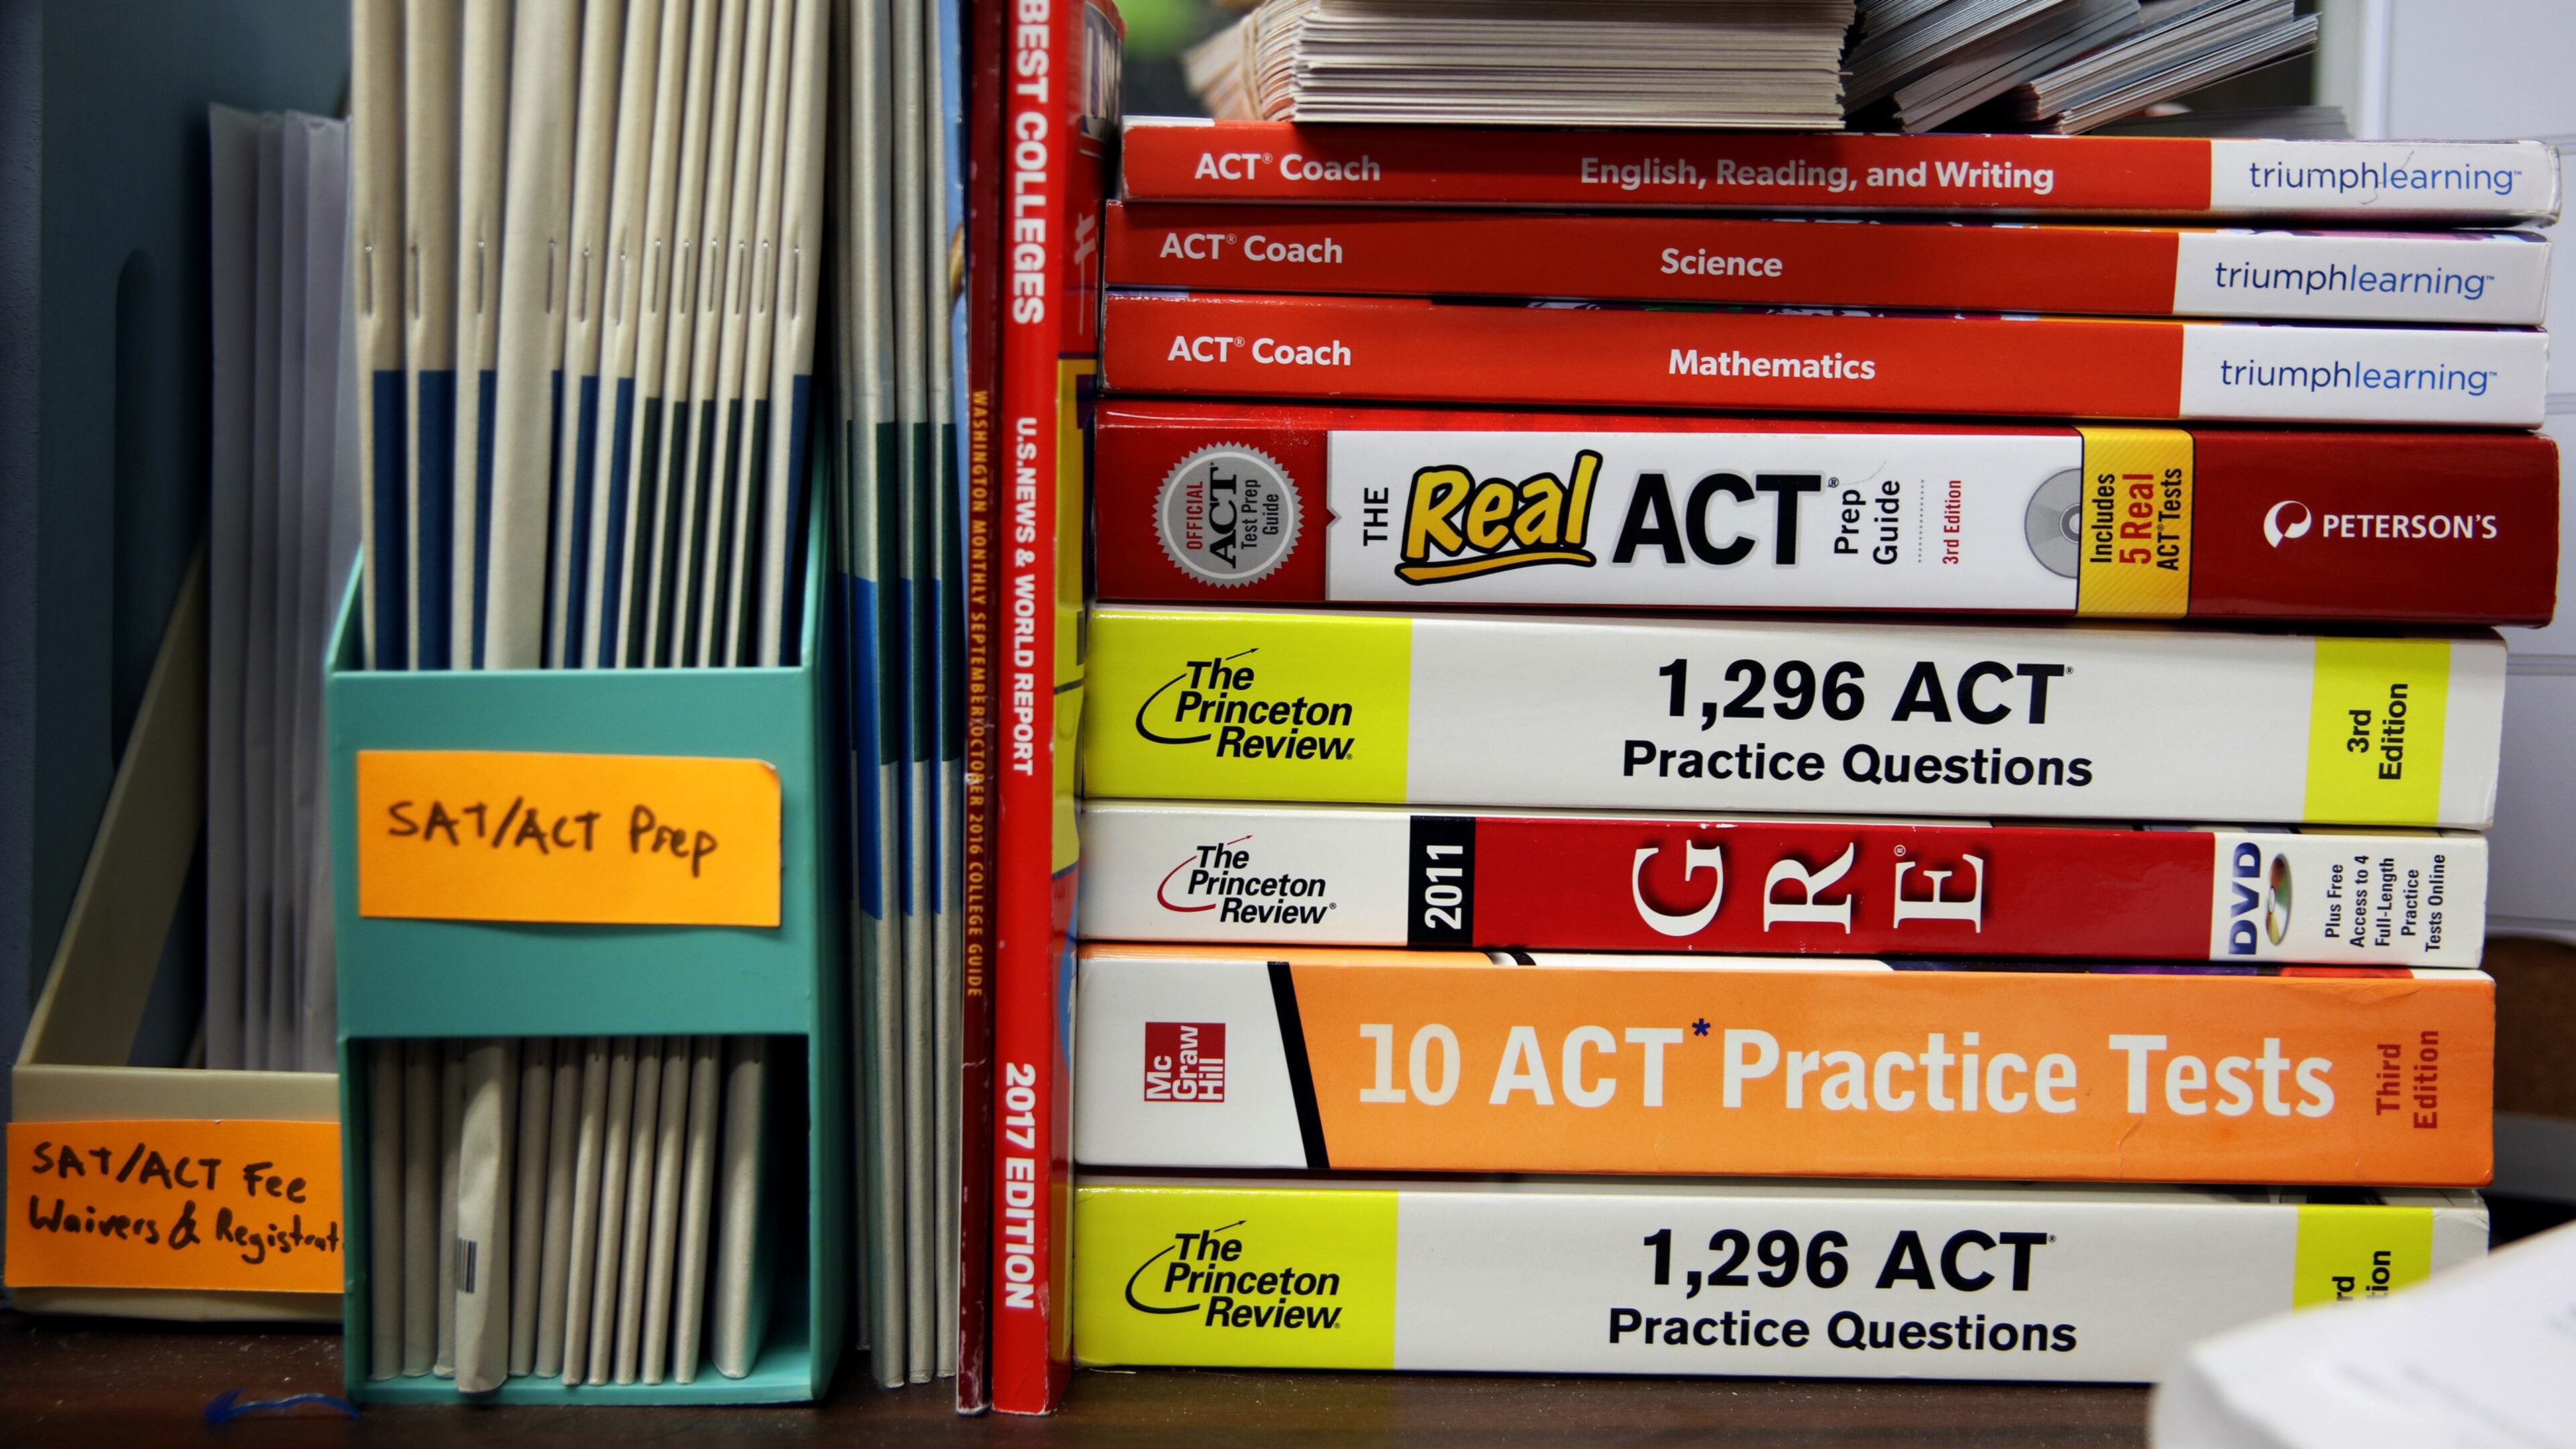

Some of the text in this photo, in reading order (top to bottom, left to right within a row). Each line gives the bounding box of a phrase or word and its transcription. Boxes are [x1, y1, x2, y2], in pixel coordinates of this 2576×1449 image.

[1013, 0, 1050, 324] BEST COLLEGES
[1279, 154, 1380, 182] Coach
[1581, 158, 2054, 194] English, Reading, and Writing
[1244, 235, 1343, 264] Coach
[1660, 248, 1783, 277] Science
[1252, 337, 1351, 367] Coach
[1668, 349, 1876, 380] Mathematics
[971, 390, 988, 513] WASHINGTON
[1186, 481, 1203, 550] OFFICIAL
[1241, 478, 1261, 549] Test Prep
[1262, 493, 1280, 536] Guide
[1363, 486, 1389, 547] THE
[1401, 449, 1603, 564] Real
[1833, 488, 1866, 554] Prep
[1872, 480, 1900, 565] Guide
[1942, 480, 1962, 565] 3rd Edition
[2090, 473, 2115, 564] Includes
[2119, 474, 2153, 564] 5 Real
[2158, 468, 2182, 522] Tests
[970, 519, 987, 605] MONTHLY
[1015, 549, 1036, 568] &
[1013, 574, 1036, 667] WORLD
[1175, 690, 1353, 727] Princeton
[1185, 657, 1254, 691] The
[1658, 658, 1865, 731] 1,296
[1012, 674, 1034, 775] REPORT
[2347, 710, 2371, 753] 3rd
[2378, 683, 2408, 780] Edition
[1623, 739, 2093, 788] Practice Questions
[388, 796, 718, 878] SAT/ACT Prep
[969, 813, 984, 855] 2016
[1196, 843, 1250, 870] The
[968, 861, 984, 936] COLLEGE
[1187, 870, 1326, 898] Princeton
[1424, 845, 1464, 930] 2011
[2228, 842, 2261, 955] DVD
[2324, 864, 2343, 938] Plus Free
[2349, 855, 2369, 948] Access to 4
[2375, 857, 2398, 946] Full-Length
[2401, 868, 2420, 936] Practice
[2425, 853, 2446, 953] Tests Online
[967, 944, 983, 996] GUIDE
[1145, 1055, 1172, 1101] Mc
[1172, 1024, 1200, 1102] Graw
[1198, 1057, 1225, 1102] Hill
[1358, 1022, 1462, 1106] 10
[1722, 1028, 2077, 1115] Practice
[2108, 1034, 2335, 1118] Tests
[2376, 1043, 2402, 1116] Third
[2413, 1030, 2439, 1130] Edition
[32, 1142, 307, 1203] SAT/ACT Fee
[1006, 1063, 1036, 1309] 2017 EDITION
[29, 1194, 343, 1265] Waivers & Registrat
[1174, 1229, 1242, 1262] The
[1643, 1228, 1849, 1299] 1,296
[1165, 1262, 1340, 1296] Princeton
[2332, 1276, 2355, 1305] rd
[1610, 1307, 2077, 1353] Practice Questions
